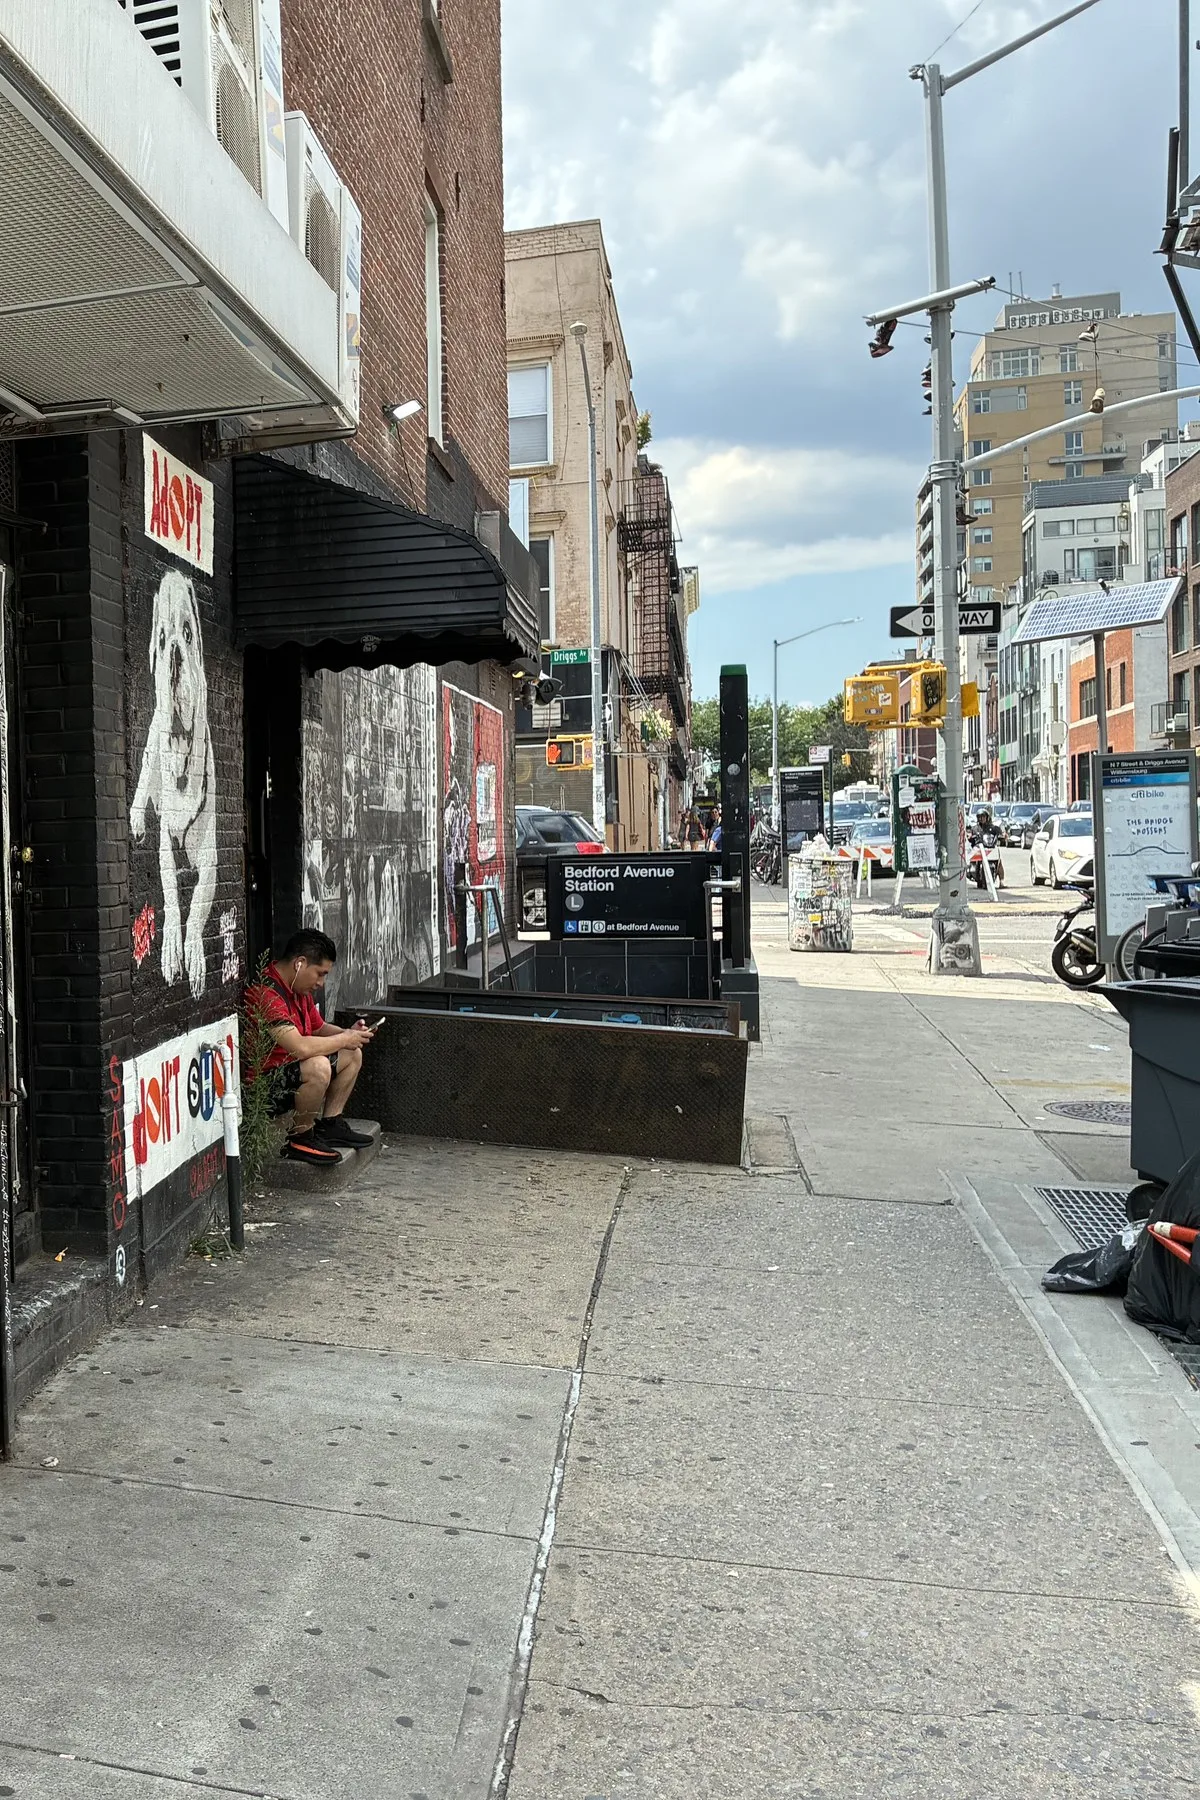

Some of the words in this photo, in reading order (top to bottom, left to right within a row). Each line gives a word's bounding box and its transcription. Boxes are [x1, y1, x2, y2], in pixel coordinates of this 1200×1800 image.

[958, 611, 989, 626] WAY
[553, 651, 578, 664] Driggs
[580, 649, 587, 657] Av
[1144, 759, 1164, 767] Driggs
[1126, 818, 1142, 826] THE
[1144, 817, 1174, 826] BRIDGE
[564, 866, 620, 879] Bedford
[623, 865, 675, 878] Avenue
[564, 879, 615, 892] Station
[616, 923, 649, 931] Bedford
[649, 923, 680, 932] Avenue
[109, 1053, 126, 1231] SAMO
